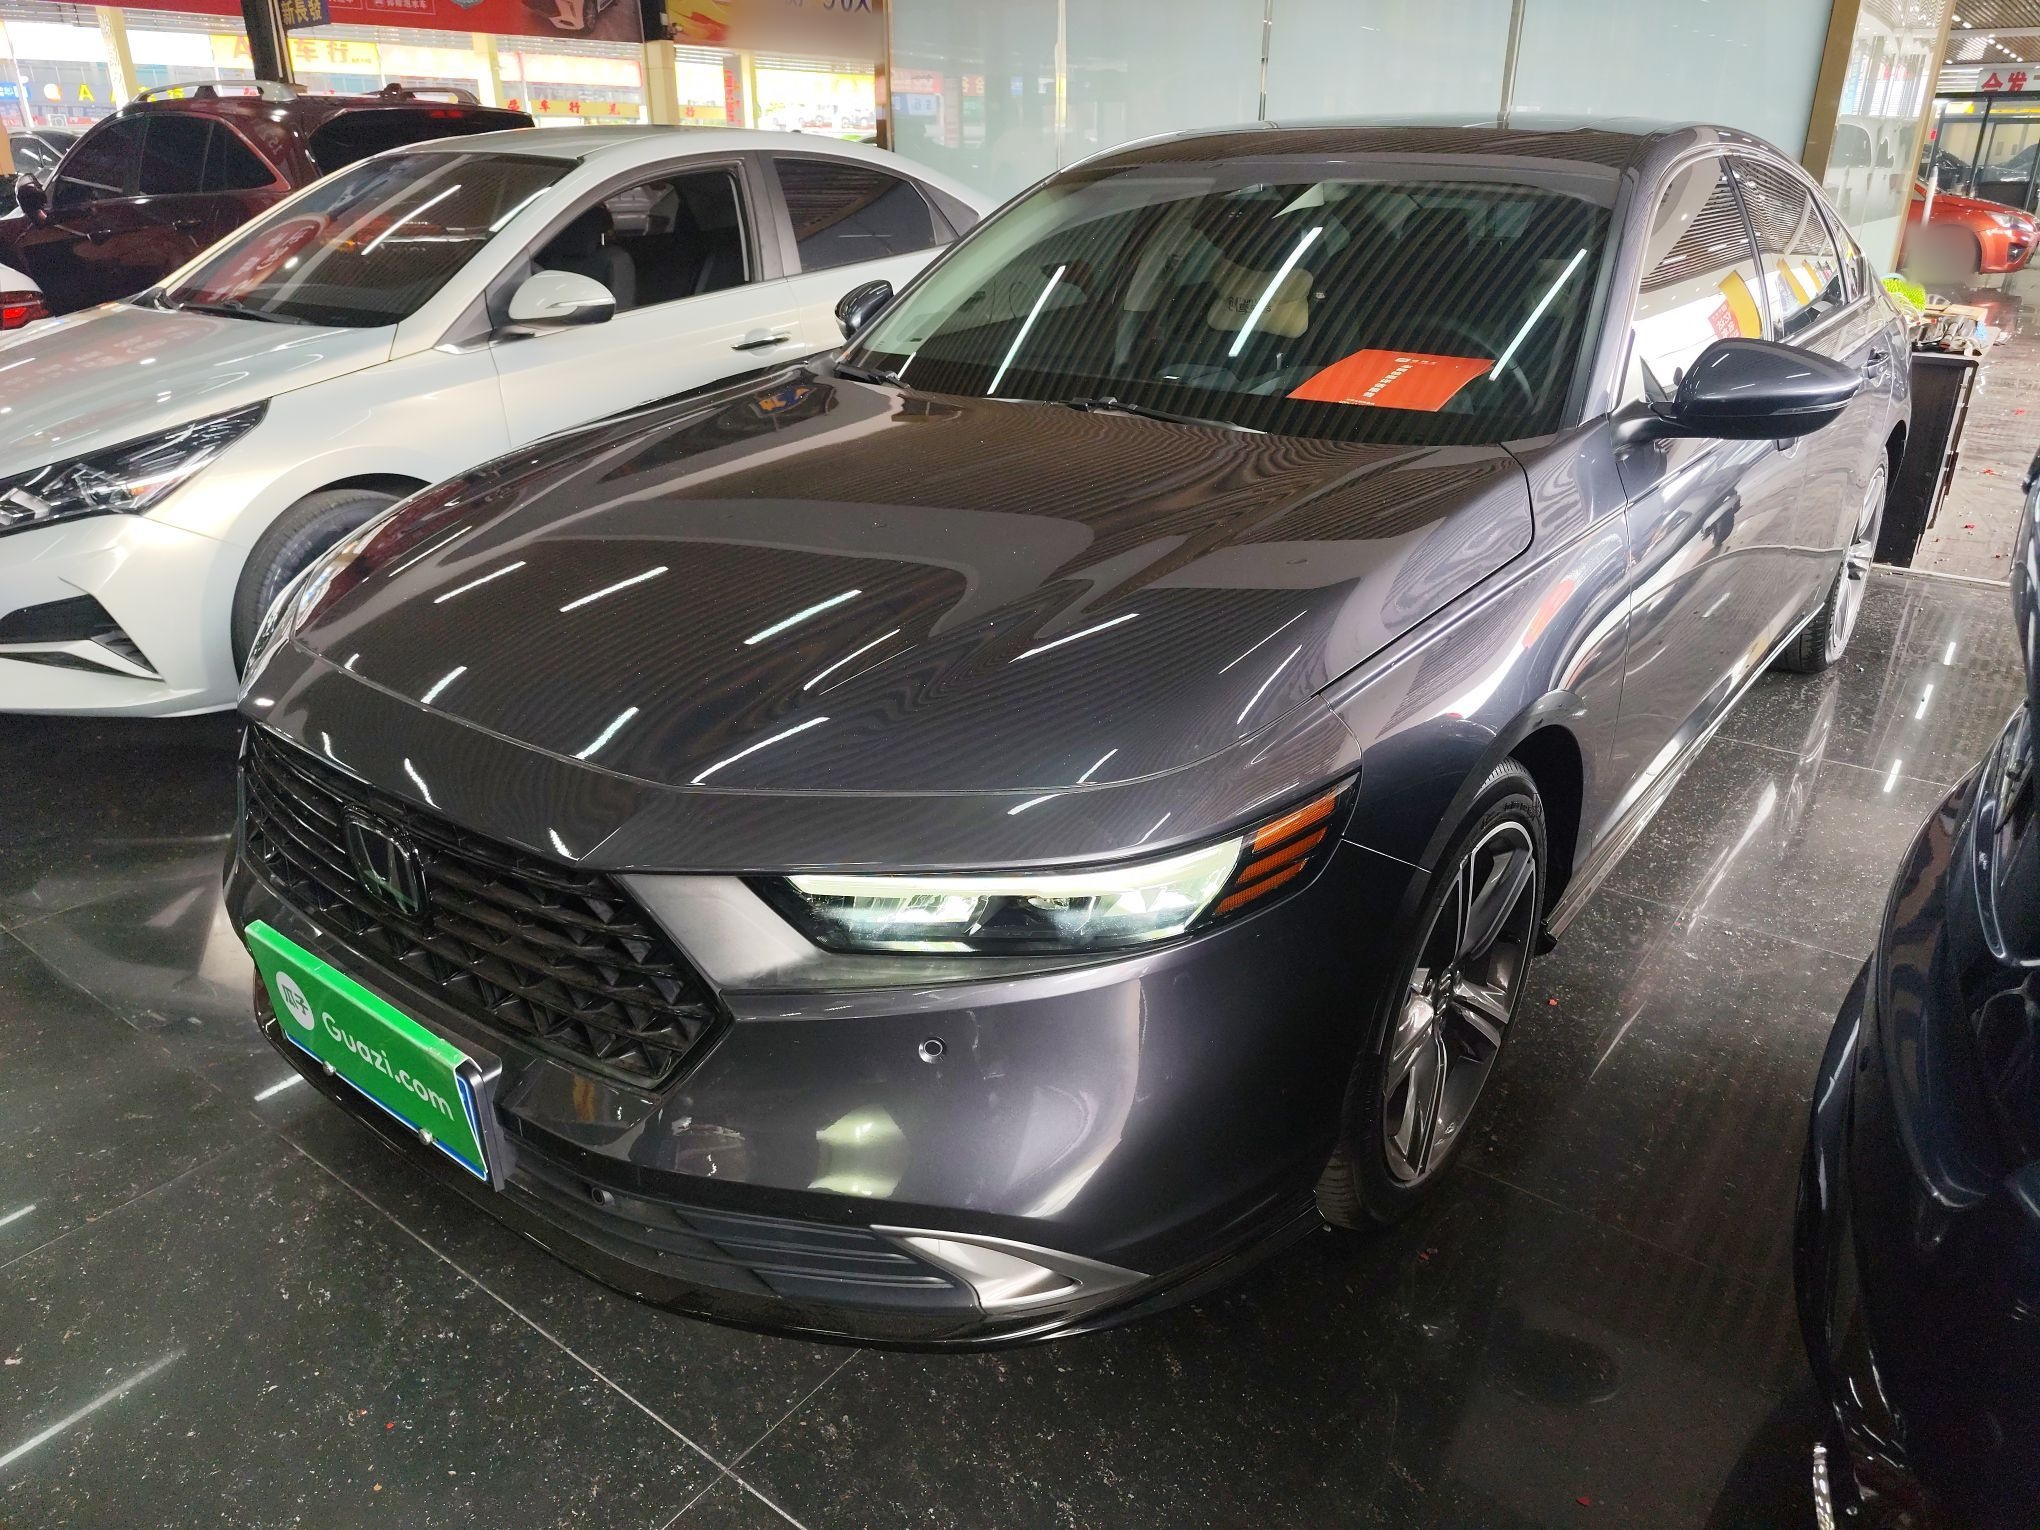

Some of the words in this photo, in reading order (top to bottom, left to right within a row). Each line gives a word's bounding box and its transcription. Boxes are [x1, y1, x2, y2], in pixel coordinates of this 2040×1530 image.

[295, 38, 349, 63] 车行
[282, 984, 308, 1015] 瓜子
[321, 1012, 455, 1121] Guazi.com
